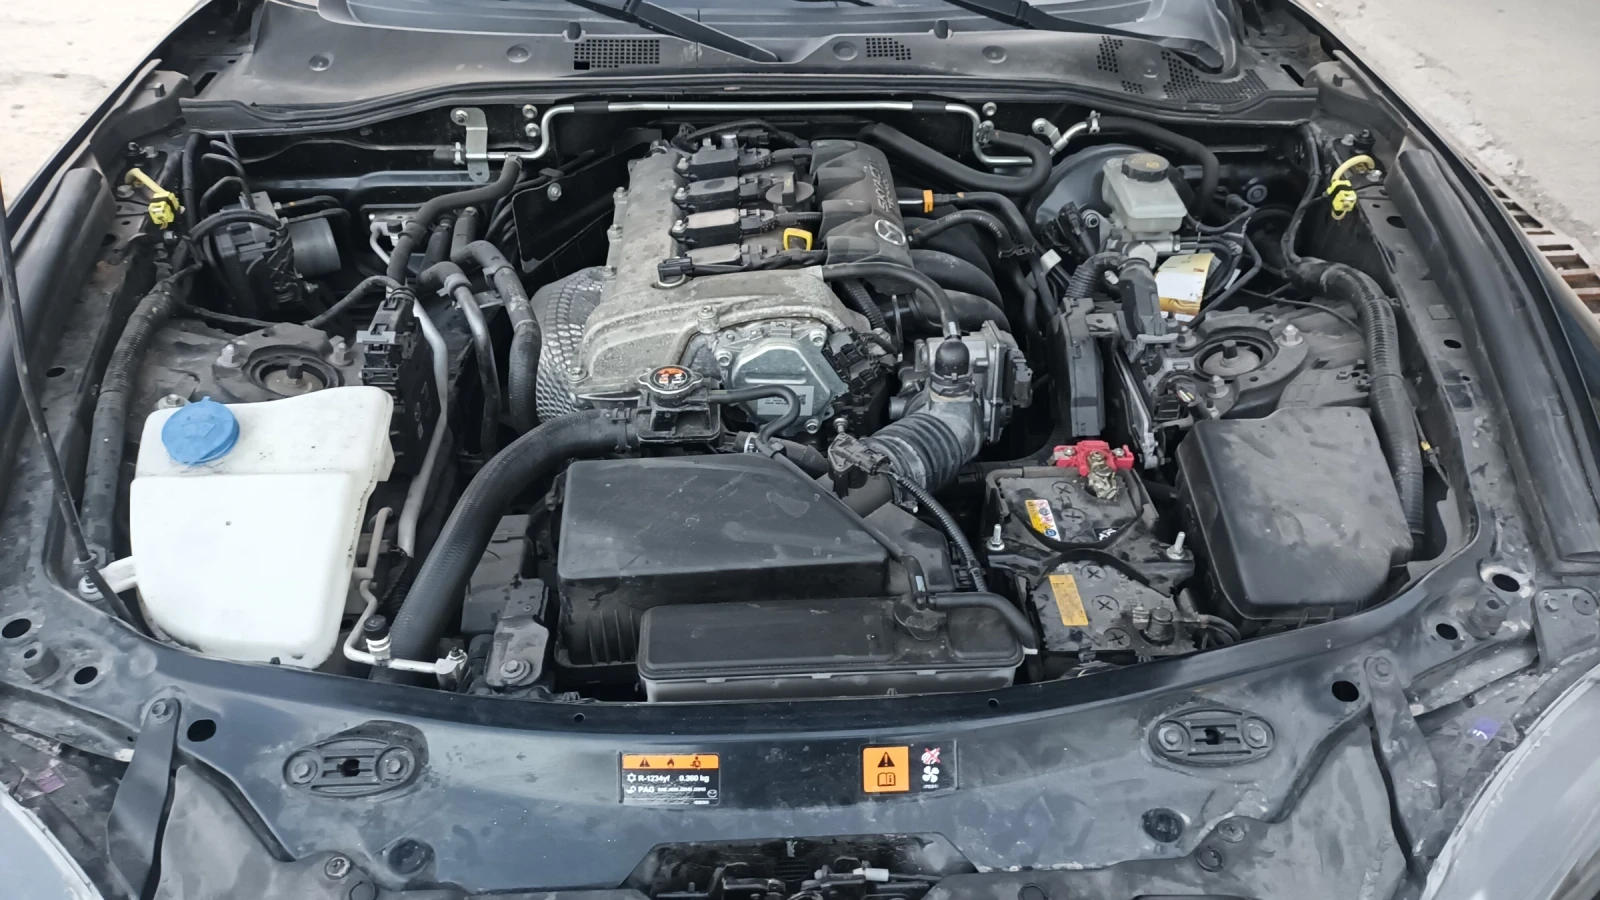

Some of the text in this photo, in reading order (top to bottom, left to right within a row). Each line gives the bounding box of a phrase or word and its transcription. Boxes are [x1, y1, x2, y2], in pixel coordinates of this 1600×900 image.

[637, 774, 670, 783] R-1234yf
[700, 774, 709, 783] kg
[637, 785, 655, 793] PAG
